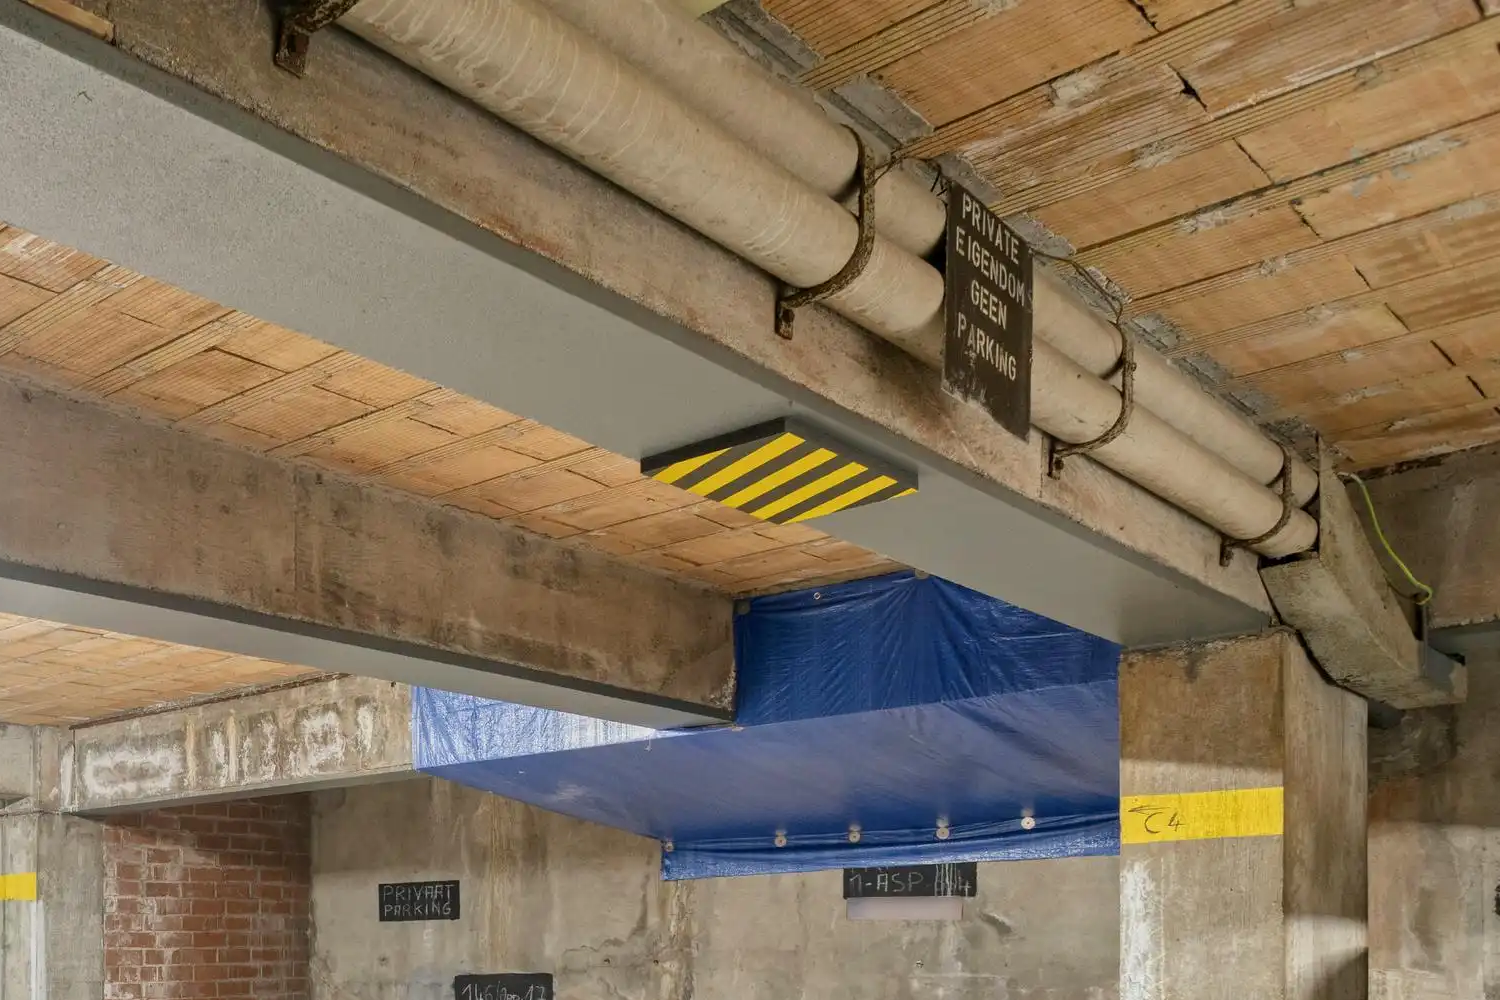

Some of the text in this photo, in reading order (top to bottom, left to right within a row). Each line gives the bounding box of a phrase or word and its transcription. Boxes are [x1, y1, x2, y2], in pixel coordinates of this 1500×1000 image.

[962, 192, 1019, 265] PRIVATE
[956, 225, 1025, 307] EIGENDOM
[971, 279, 1007, 330] GEEN
[957, 311, 1017, 381] PARKING
[383, 902, 452, 917] PARKING
